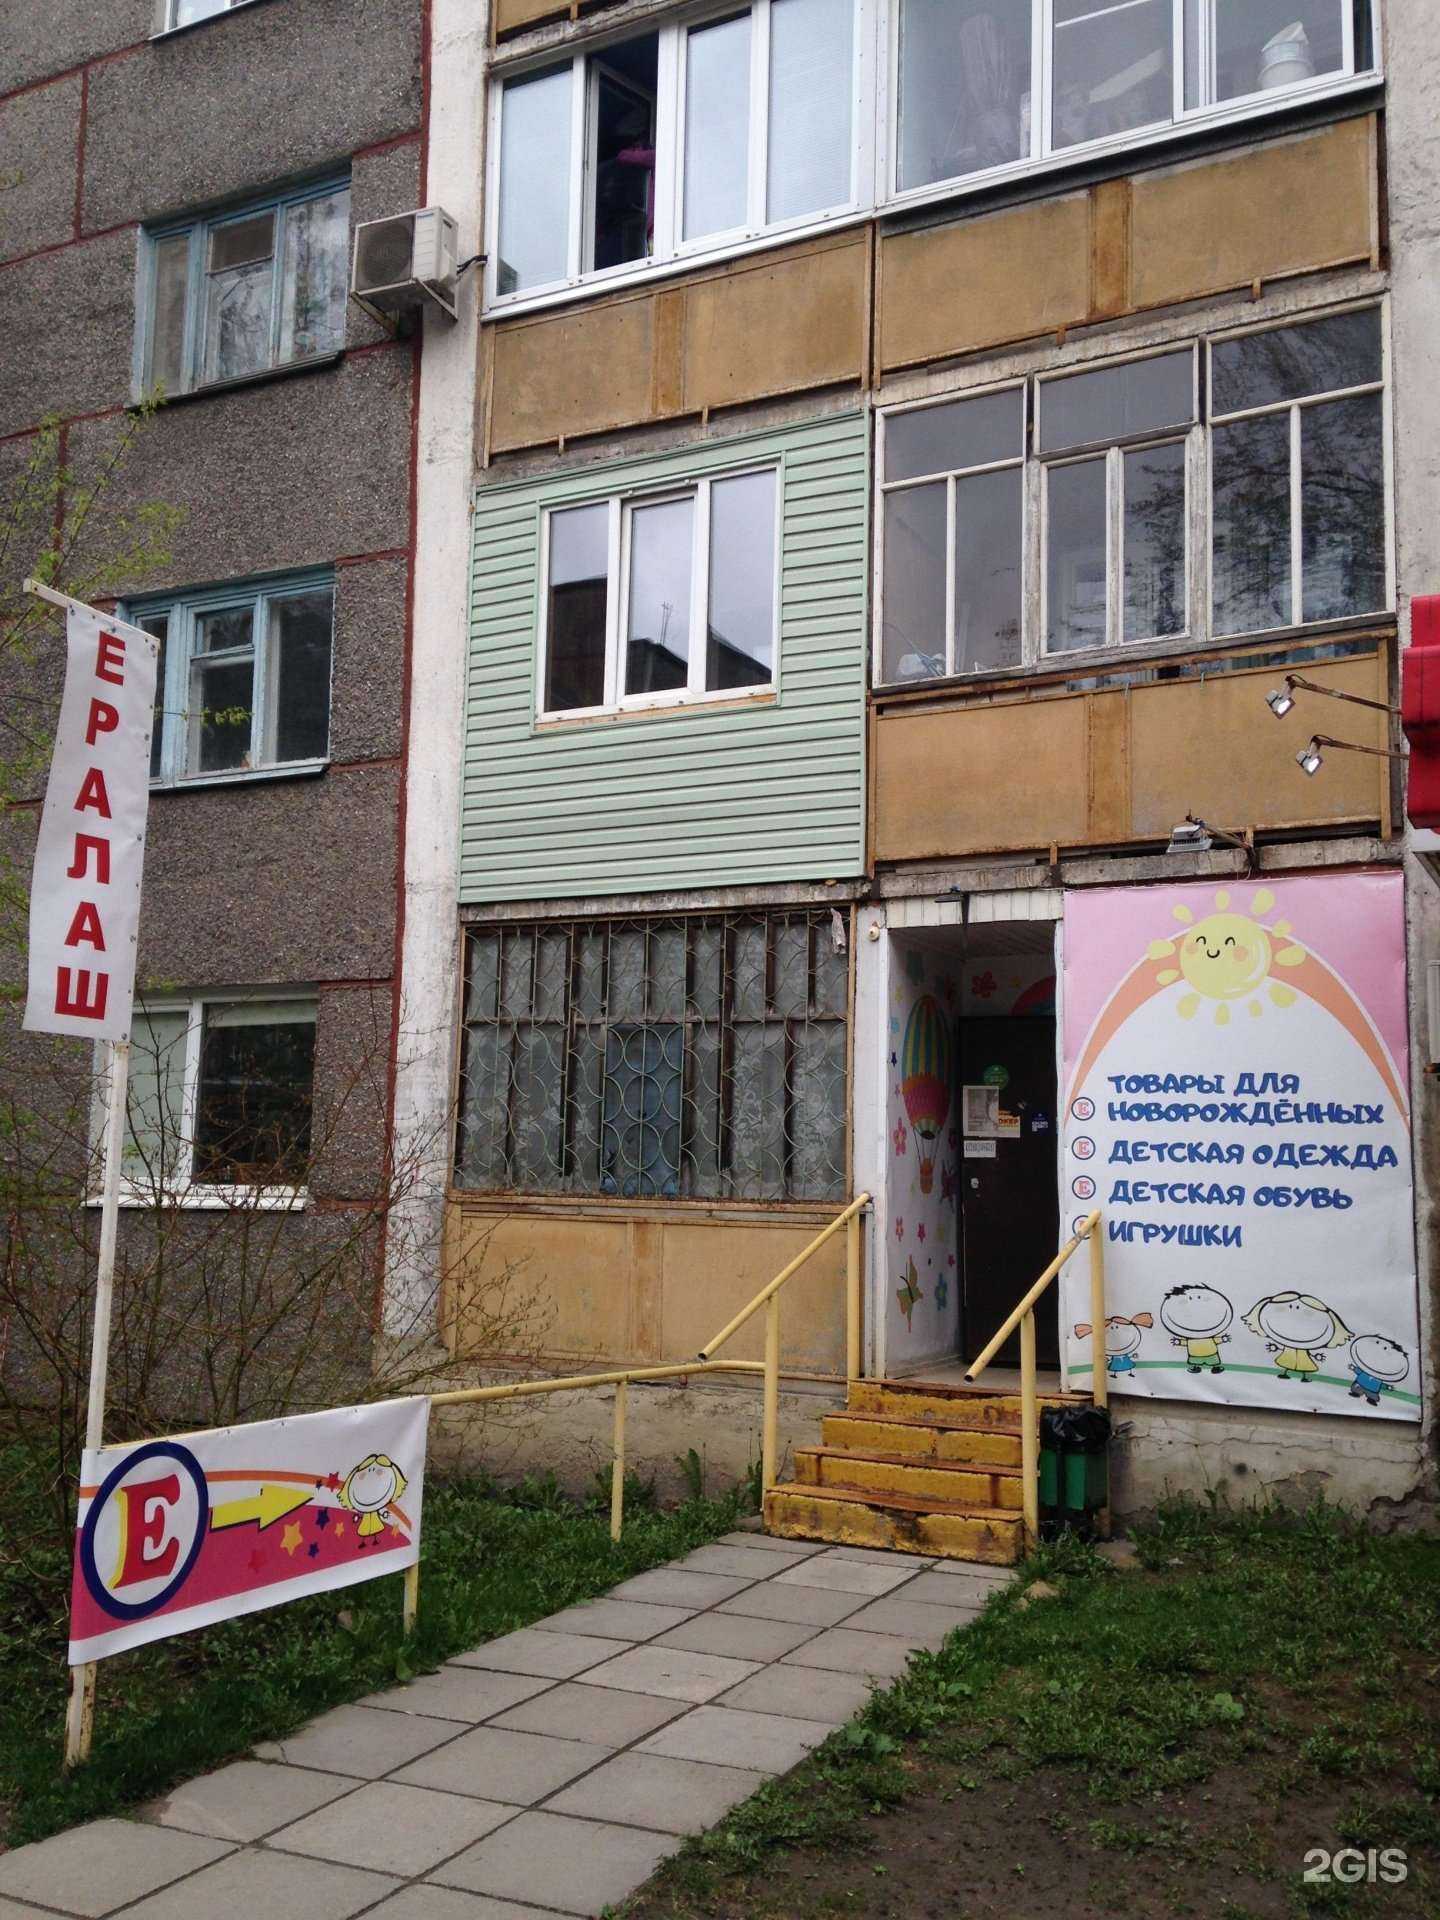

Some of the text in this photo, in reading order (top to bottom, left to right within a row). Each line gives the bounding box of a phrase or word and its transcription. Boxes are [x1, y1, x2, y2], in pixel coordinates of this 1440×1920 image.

[54, 630, 127, 1021] ЕРАЛАШ
[1107, 1072, 1300, 1097] ТОВАРЫ ДЛЯ
[1107, 1099, 1384, 1126] НОВОРОЖДЁННЫХ
[1108, 1140, 1245, 1165] ДЕТСКАЯ
[1252, 1143, 1399, 1171] ОДЕЖДА
[1108, 1180, 1246, 1206] ДЕТСКАЯ
[1253, 1186, 1353, 1210] ОБУВЬ
[1108, 1220, 1243, 1248] ИГРУШКИ
